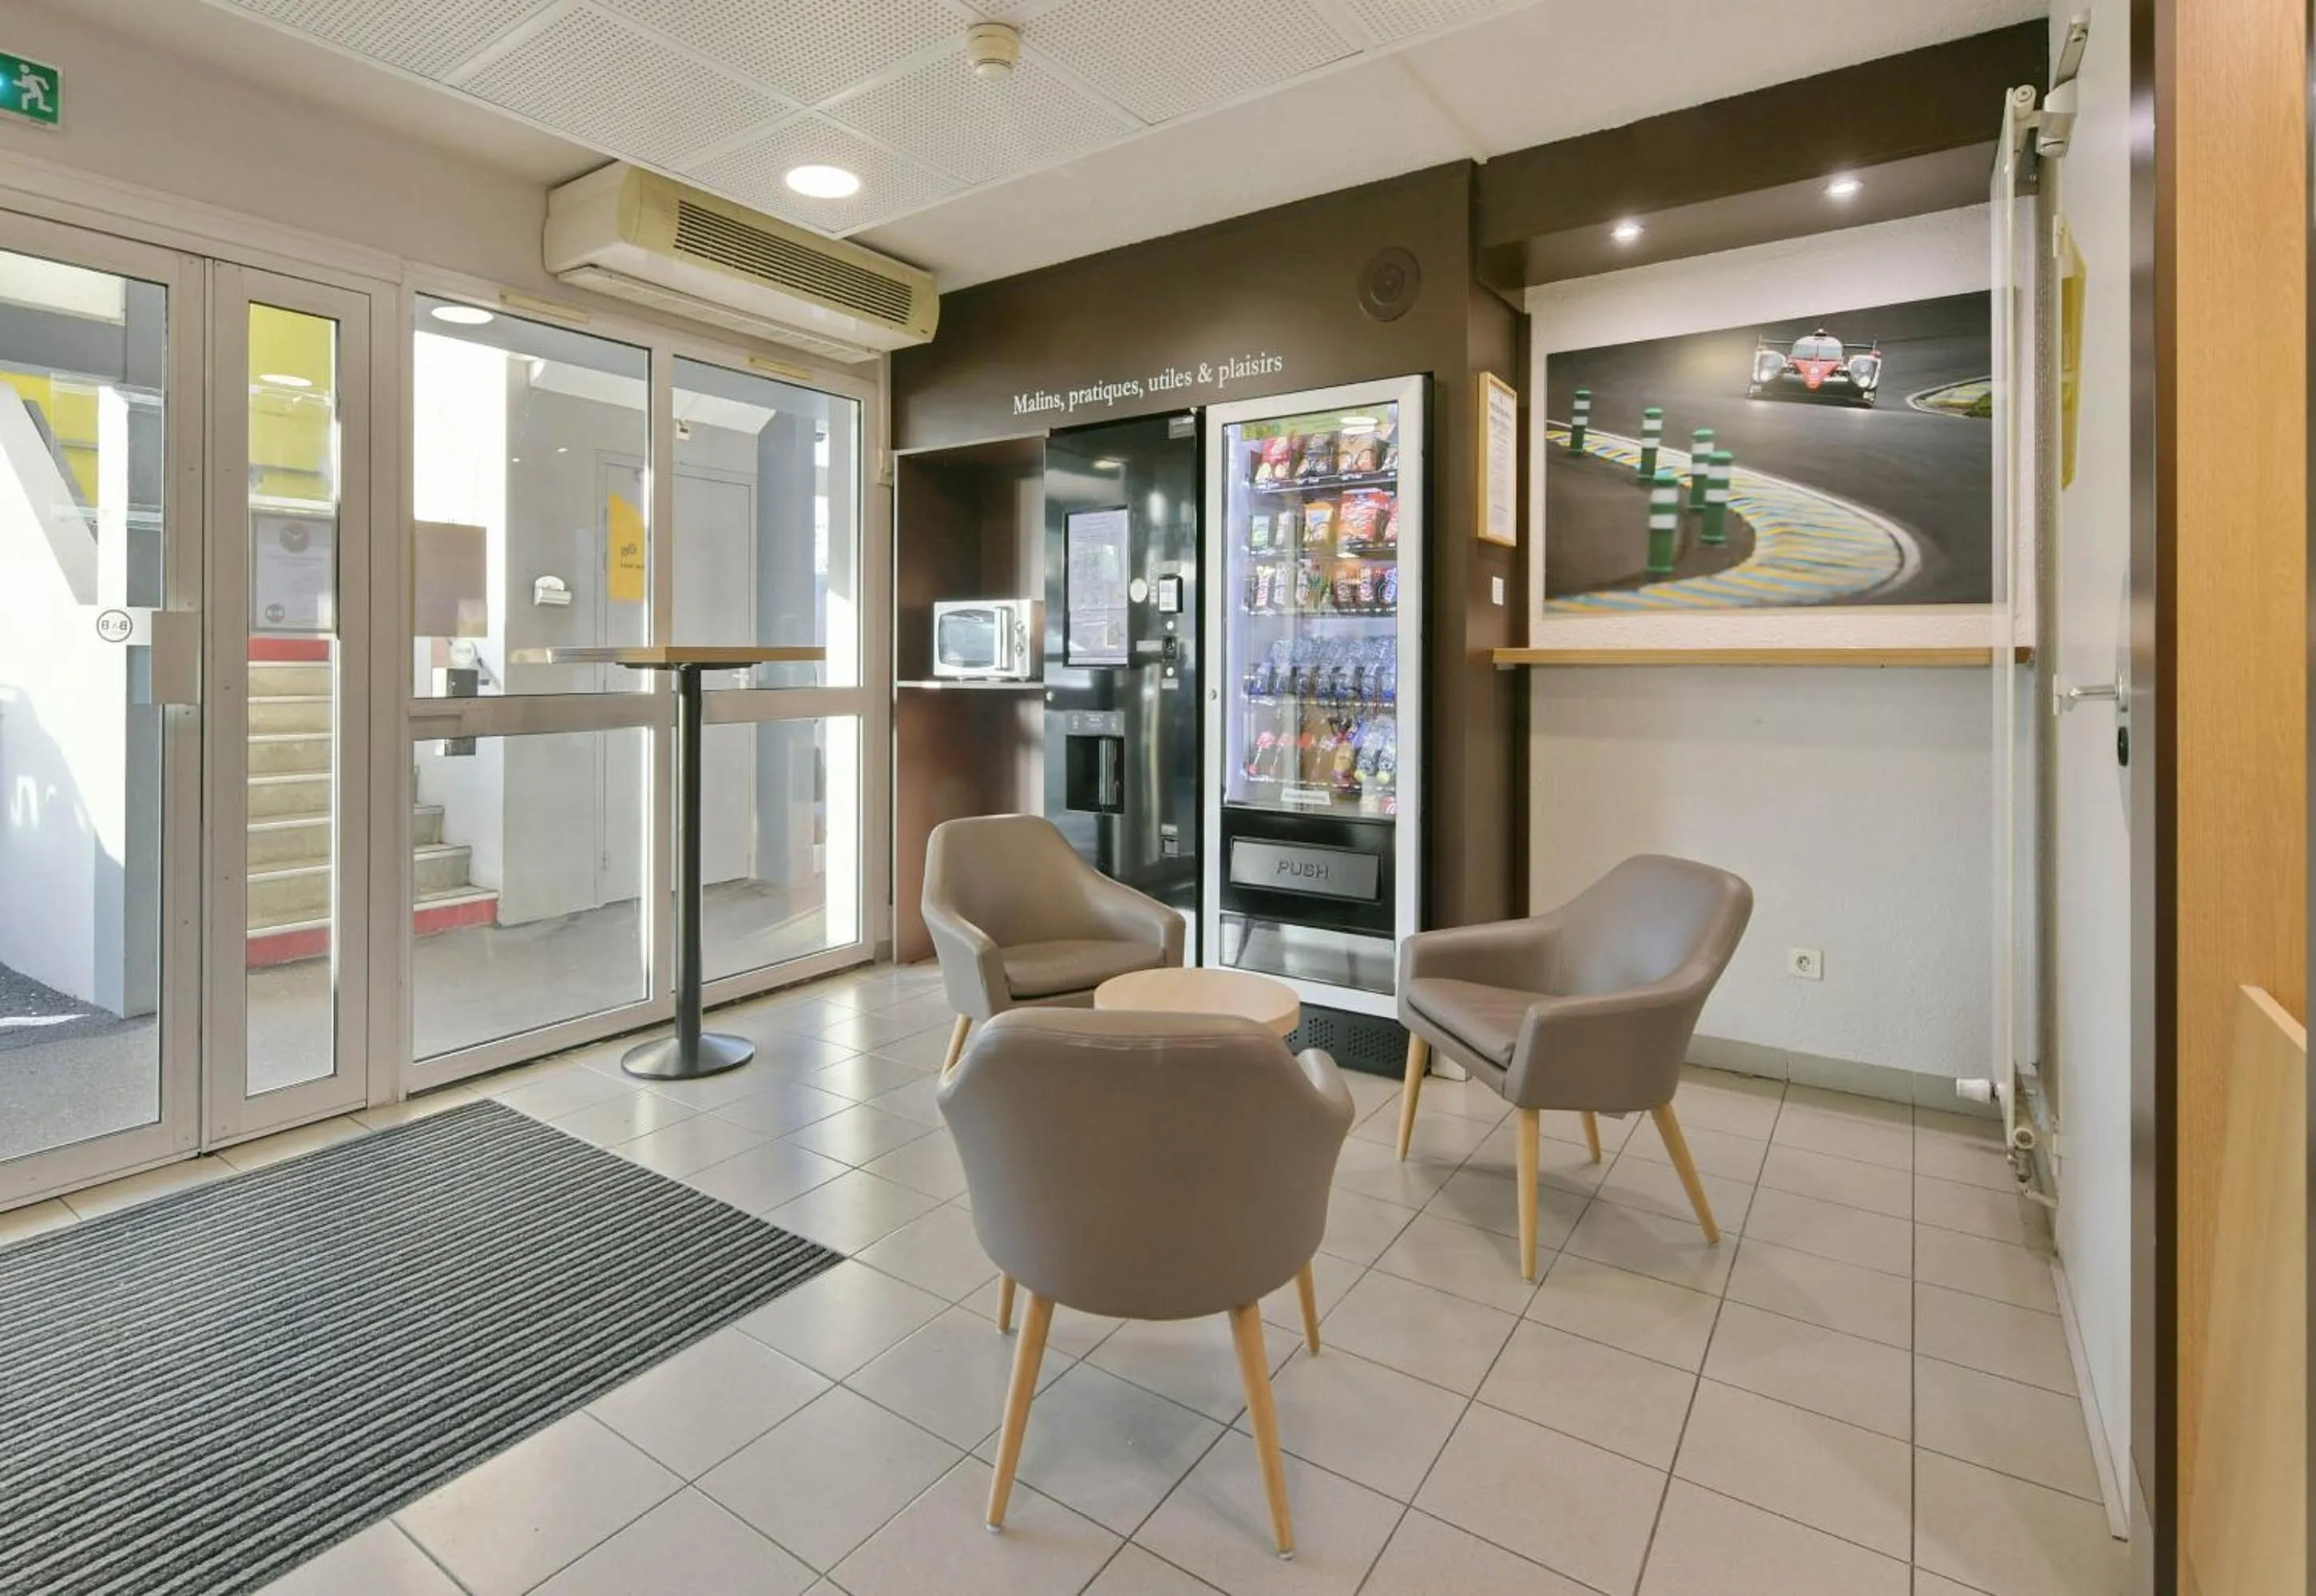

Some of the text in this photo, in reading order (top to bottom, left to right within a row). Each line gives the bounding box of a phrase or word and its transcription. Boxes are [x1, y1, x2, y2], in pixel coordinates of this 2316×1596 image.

[1013, 351, 1283, 414] Malins, pratiques, utiles & plaisirs
[1276, 860, 1329, 880] PUSH
